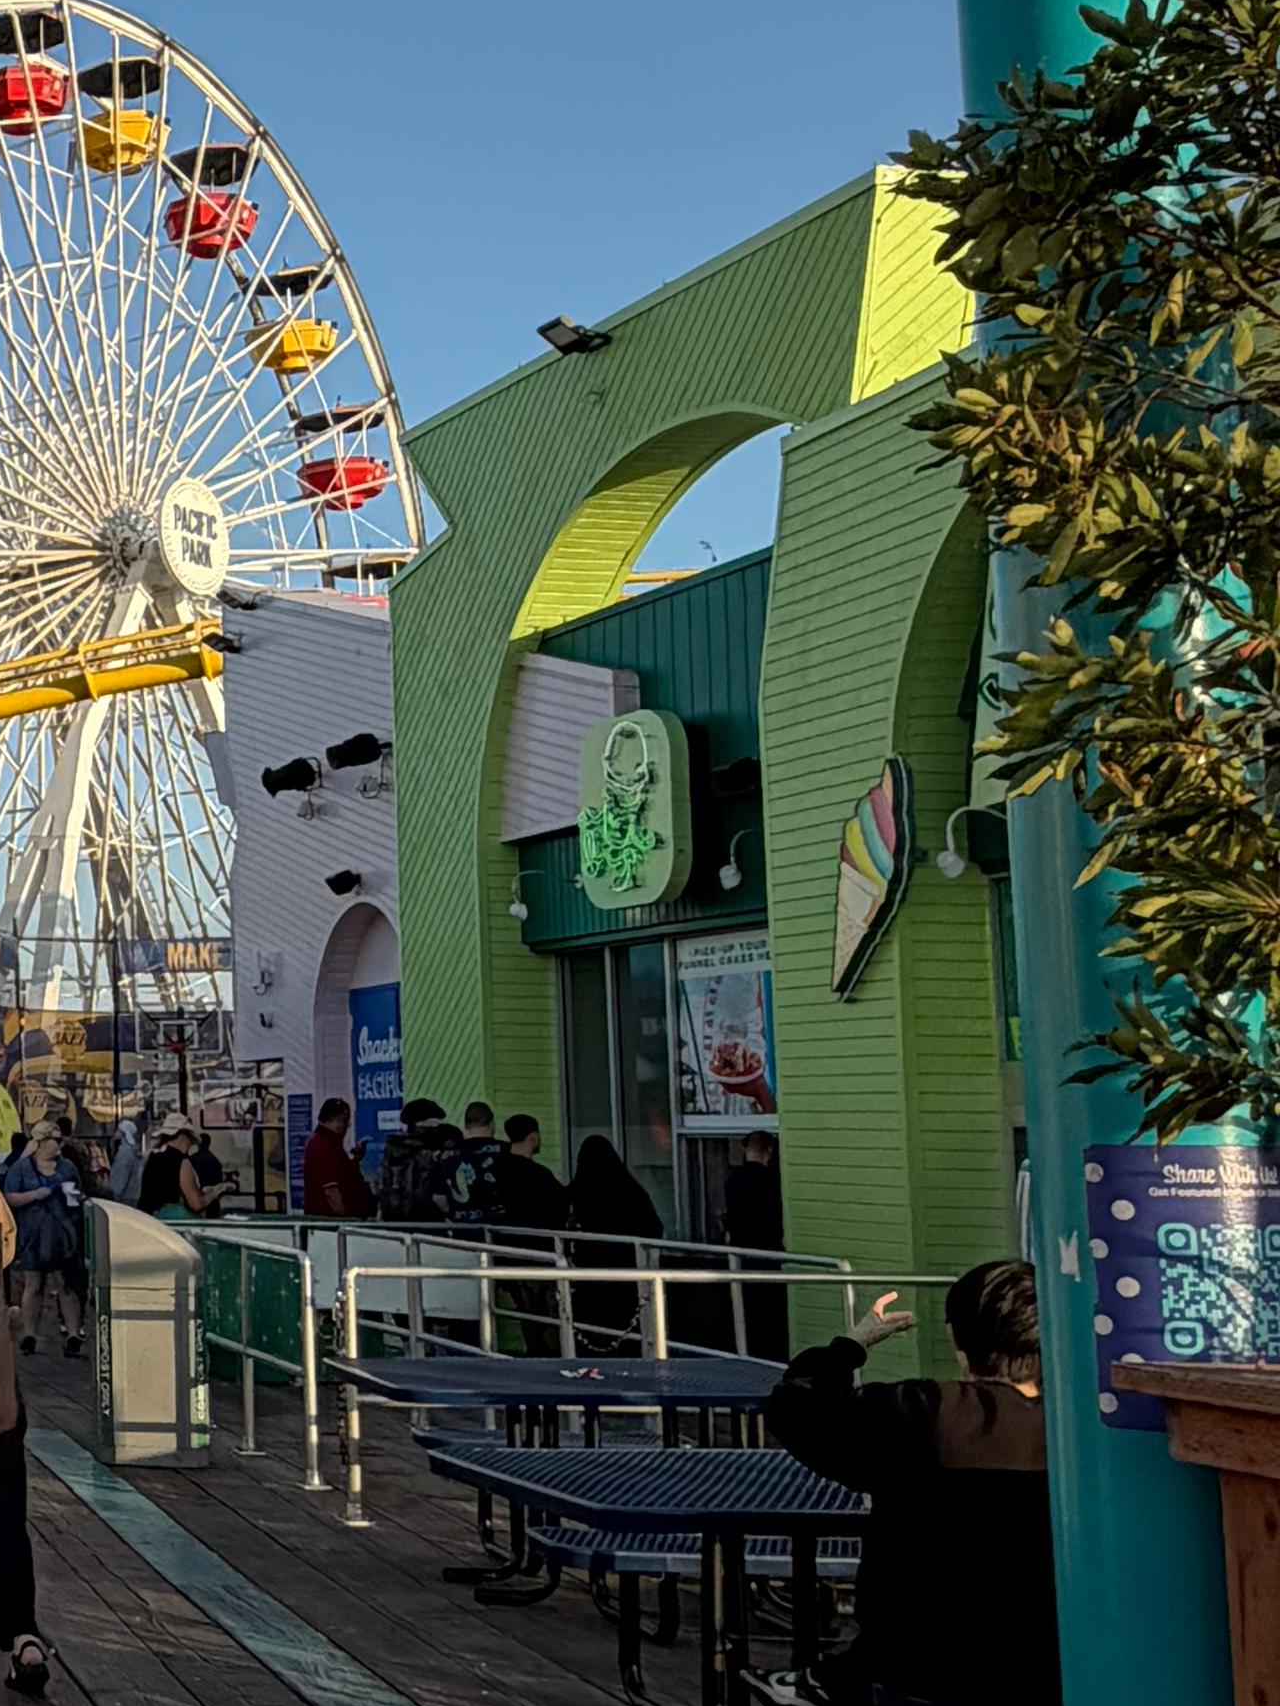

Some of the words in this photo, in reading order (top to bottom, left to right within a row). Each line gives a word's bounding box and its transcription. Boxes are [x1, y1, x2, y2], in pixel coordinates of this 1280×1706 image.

[173, 503, 218, 541] PACIFIC
[181, 535, 213, 569] PARK
[677, 958, 716, 970] FUNNEL
[719, 953, 754, 966] CAKES
[1162, 1162, 1216, 1185] Share
[1218, 1160, 1259, 1185] With
